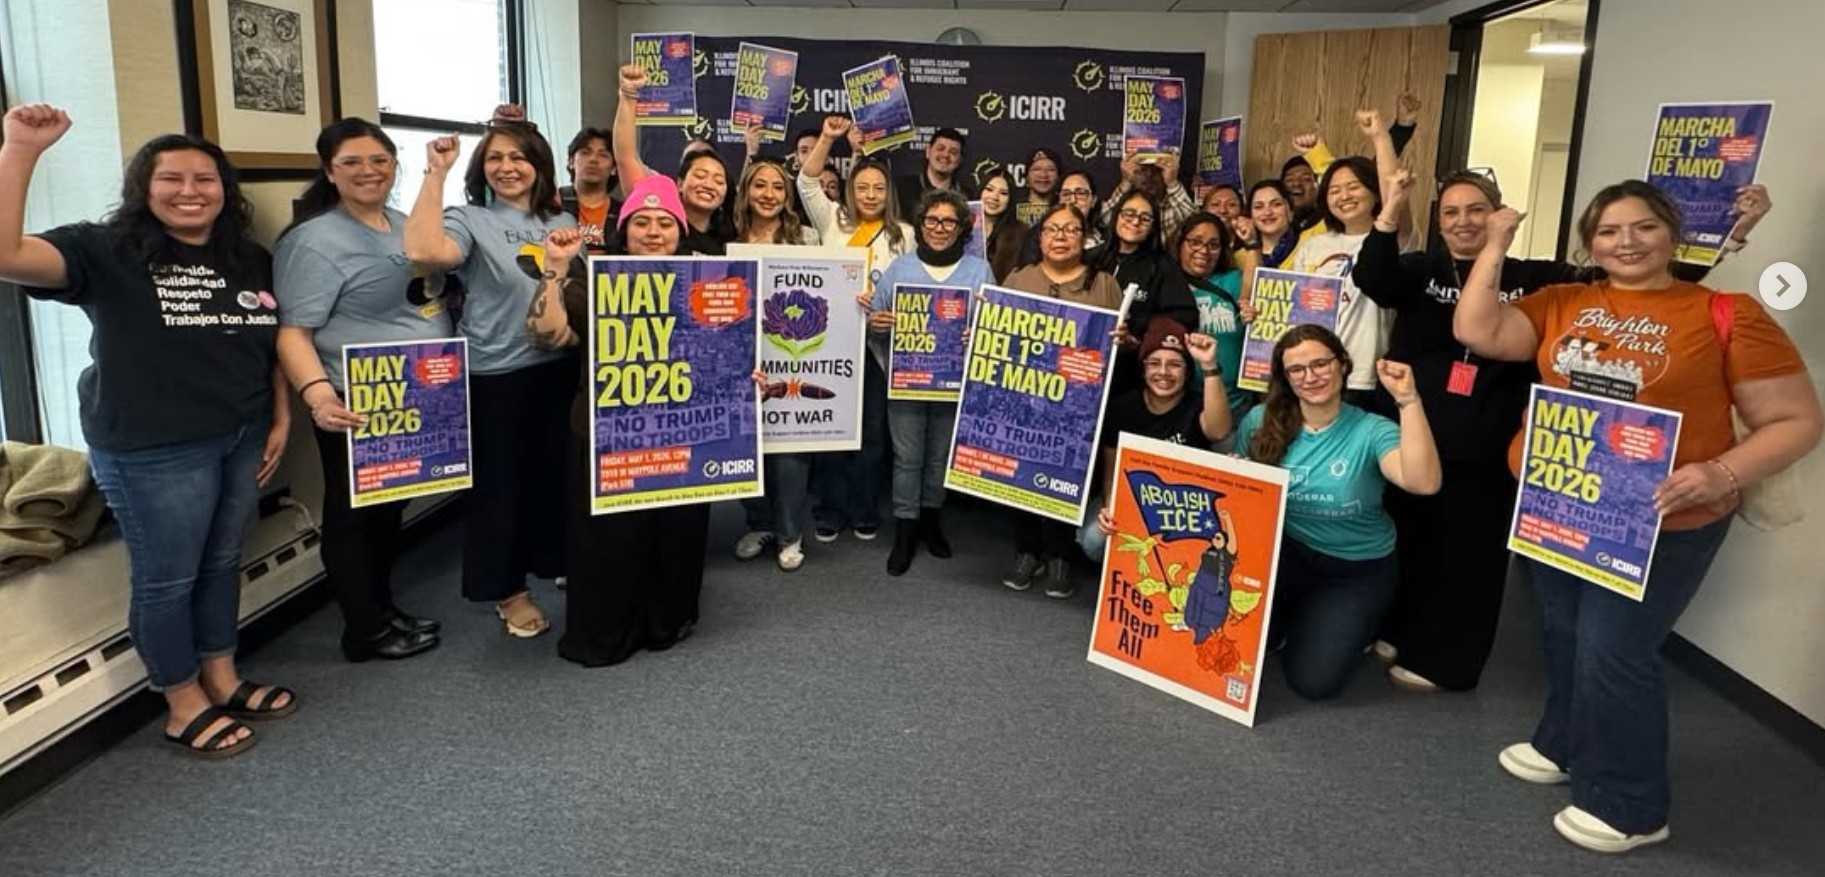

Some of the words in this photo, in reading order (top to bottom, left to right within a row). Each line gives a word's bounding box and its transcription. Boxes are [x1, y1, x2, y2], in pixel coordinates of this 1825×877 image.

[635, 40, 662, 54] MAY
[742, 50, 768, 68] MAY
[909, 58, 936, 67] ILLINOIS
[936, 59, 970, 68] COALITION
[645, 70, 669, 87] 026
[741, 66, 766, 84] DAY
[848, 67, 886, 87] MARCHA
[909, 66, 922, 75] FOR
[943, 76, 967, 85] RIGHTS
[738, 82, 769, 100] 2026
[865, 89, 890, 106] MAYO
[1128, 81, 1155, 94] MAY
[1009, 95, 1067, 121] ICIRR
[1129, 94, 1155, 109] DAY
[1127, 109, 1161, 124] 2026
[1659, 117, 1736, 138] MARCHA
[1655, 138, 1684, 156] DEL
[1652, 157, 1673, 176] DE
[1676, 158, 1724, 179] MAYO
[152, 275, 226, 289] Solidardad
[774, 273, 824, 289] FUND
[1257, 278, 1297, 300] MAY
[157, 287, 212, 300] Respeto
[597, 273, 676, 315] MAY
[897, 292, 932, 312] MAY
[160, 301, 201, 312] Poder
[1256, 298, 1295, 322] DAY
[162, 314, 219, 327] Trabajos
[221, 313, 243, 325] Con
[896, 313, 930, 333] DAY
[979, 302, 1077, 348] MARCHA
[1250, 320, 1297, 342] 202
[1574, 307, 1670, 336] Brighton
[598, 316, 676, 363] DAY
[894, 333, 936, 353] 2026
[974, 329, 1012, 362] DEL
[1615, 333, 1667, 356] Park
[351, 355, 407, 383] MAY
[762, 359, 853, 378] MMUNITIES
[969, 355, 997, 386] DE
[1002, 363, 1067, 402] MAYO
[597, 362, 693, 408] 2026
[352, 382, 408, 413] DAY
[354, 408, 422, 439] 2026
[614, 416, 646, 434] NO
[654, 405, 726, 430] TRUMP
[795, 409, 833, 425] WAR
[1535, 399, 1599, 438] MAY
[395, 433, 446, 449] TRUMP
[614, 435, 643, 451] NO
[649, 423, 727, 447] TROOPS
[972, 418, 997, 435] NO
[1005, 426, 1065, 449] TRUMP
[970, 433, 992, 448] NO
[996, 439, 1062, 464] TROOPS
[1532, 428, 1596, 470] DAY
[722, 459, 755, 475] ICIRR
[1048, 477, 1080, 497] ICIRR
[1527, 458, 1602, 503] 2026
[1141, 483, 1211, 511] ABOLISH
[1157, 510, 1202, 532] ICE
[1536, 494, 1558, 509] NO
[1566, 502, 1625, 528] TRUMP
[1111, 570, 1153, 616] Free
[1108, 597, 1159, 639] Them
[1118, 628, 1143, 660] All
